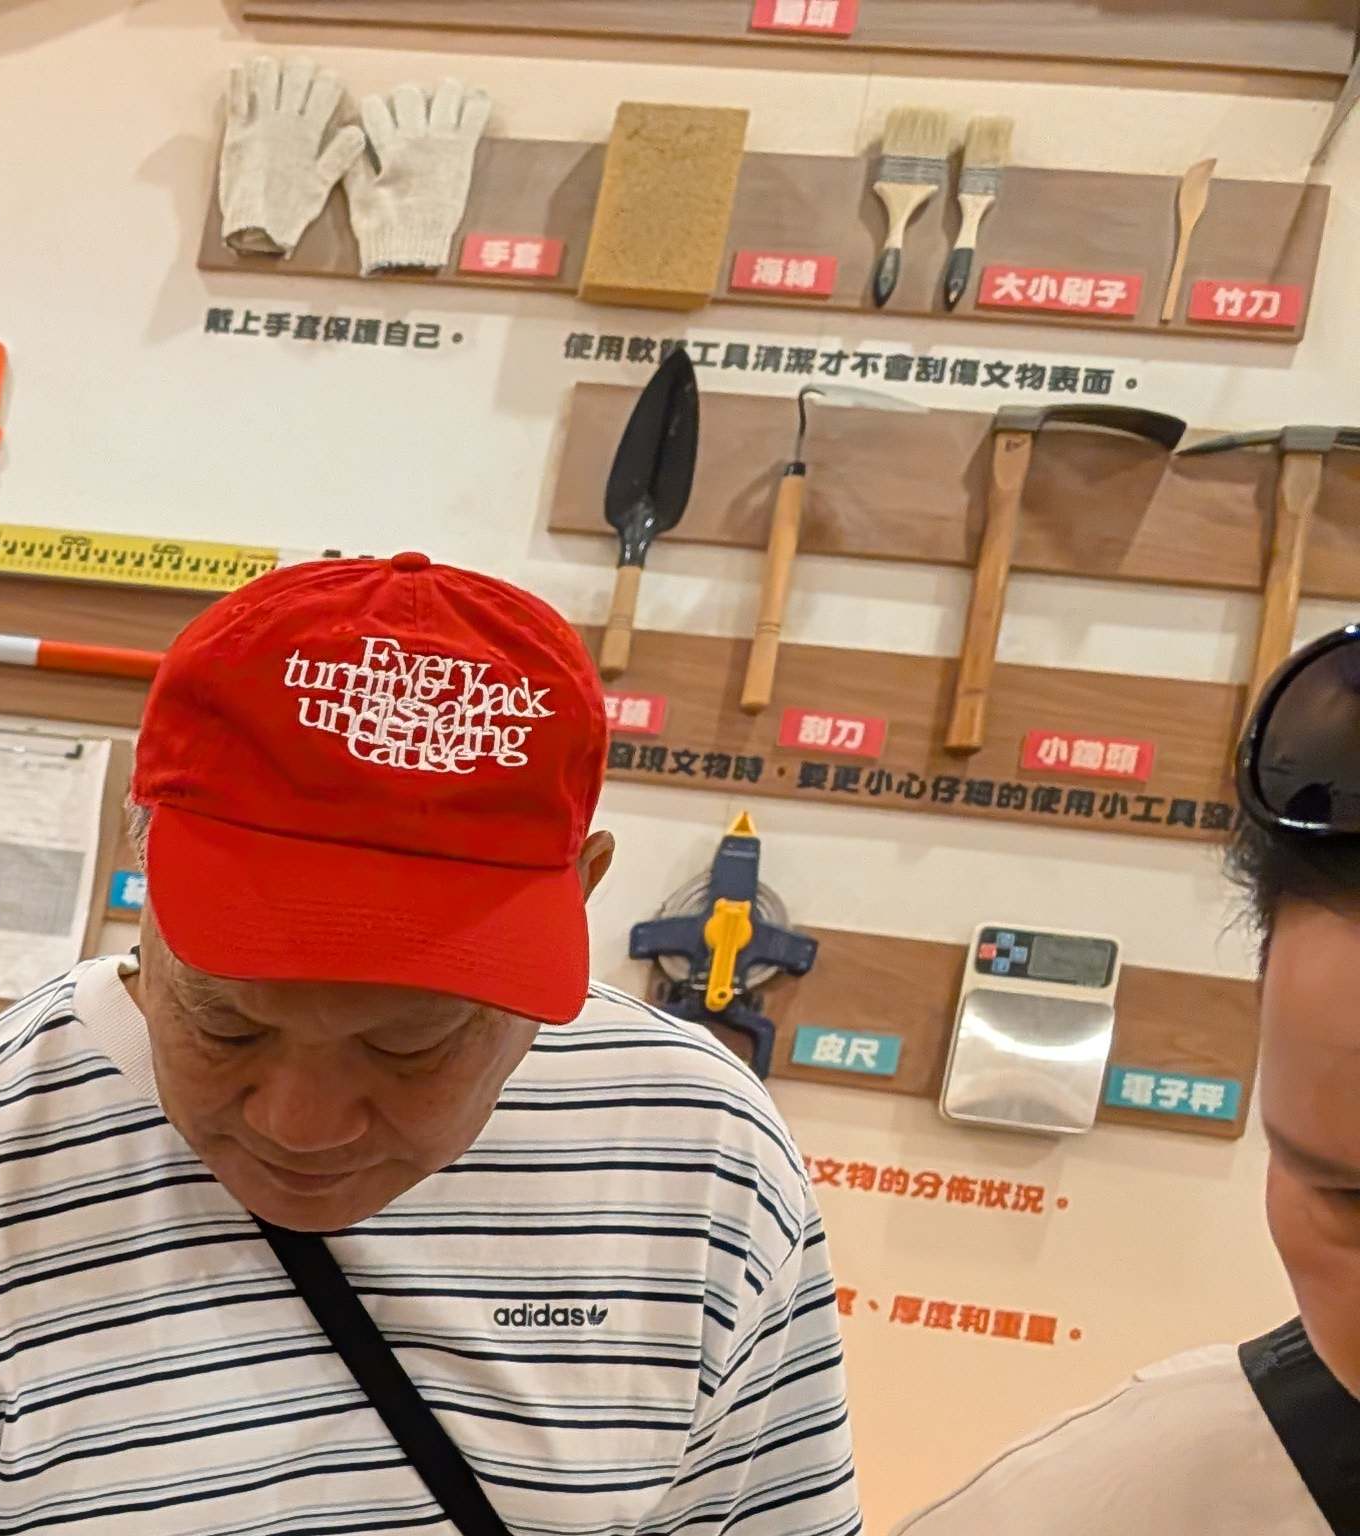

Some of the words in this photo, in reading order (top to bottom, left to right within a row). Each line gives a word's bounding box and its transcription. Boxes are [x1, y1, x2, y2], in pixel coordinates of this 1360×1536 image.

[480, 240, 544, 271] 手套
[991, 271, 1128, 309] 大小刷子
[1212, 286, 1281, 319] 竹刀
[204, 307, 464, 350] 戴上手套保護自己。
[361, 636, 492, 700] Every
[458, 665, 556, 718] back
[811, 1031, 880, 1069] 皮尺
[1120, 1071, 1225, 1114] 電子秤
[493, 1302, 585, 1328] adidas
